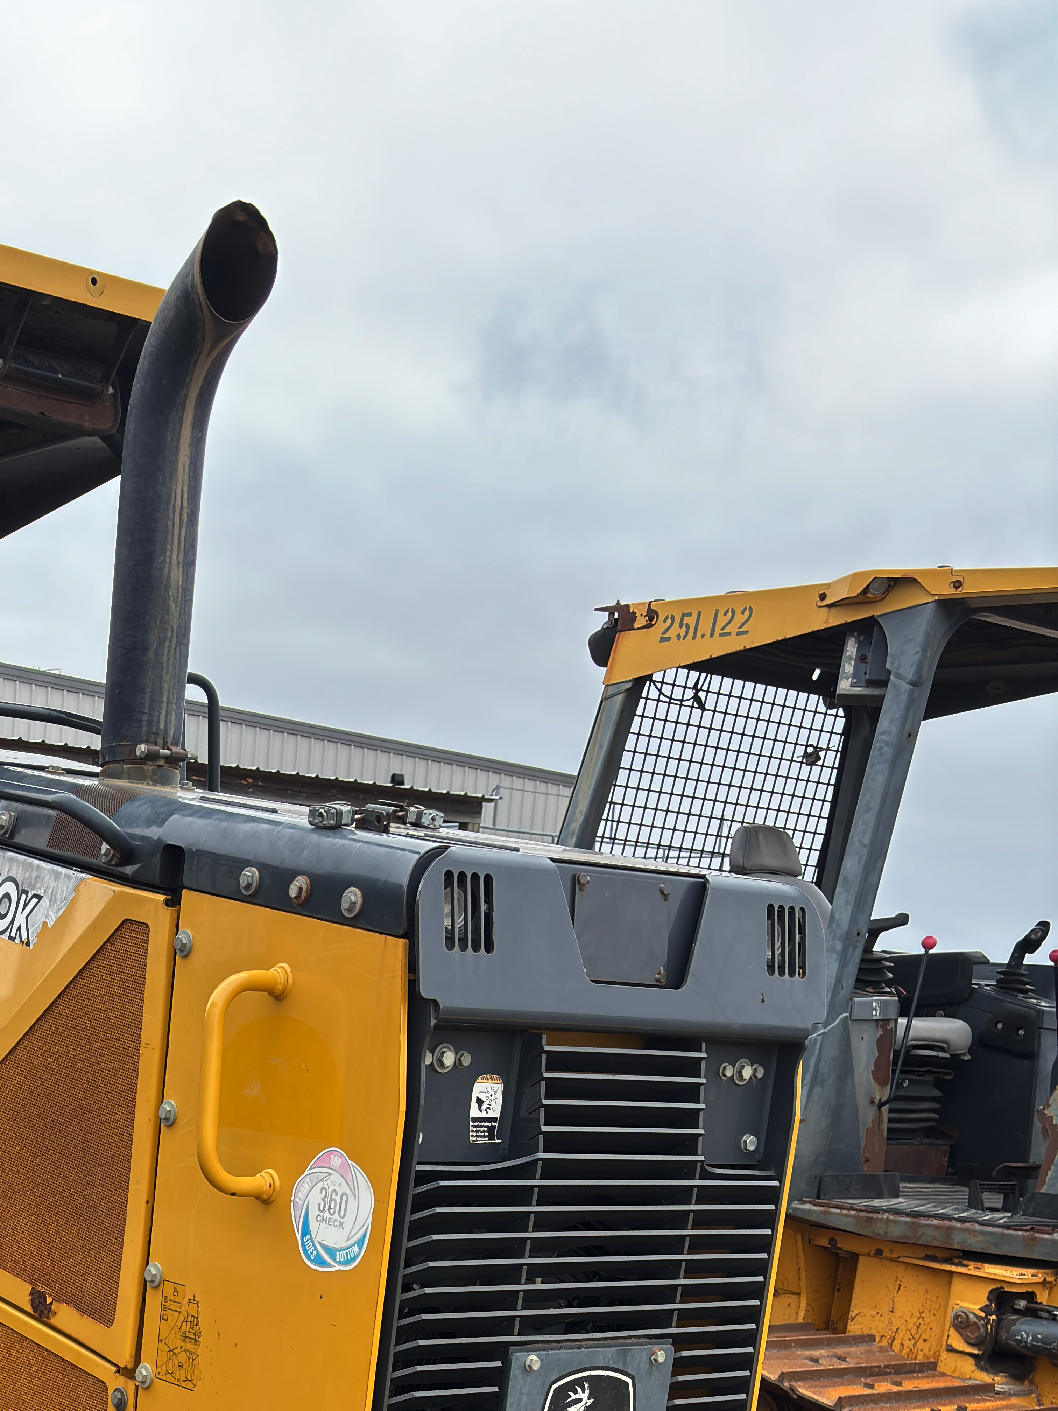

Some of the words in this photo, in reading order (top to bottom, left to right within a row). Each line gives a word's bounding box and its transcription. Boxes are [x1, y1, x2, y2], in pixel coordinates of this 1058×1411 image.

[658, 604, 754, 644] 251.122
[330, 1154, 343, 1168] TOP
[317, 1186, 350, 1220] 360
[315, 1213, 345, 1230] CHECK
[303, 1234, 317, 1260] SIDES
